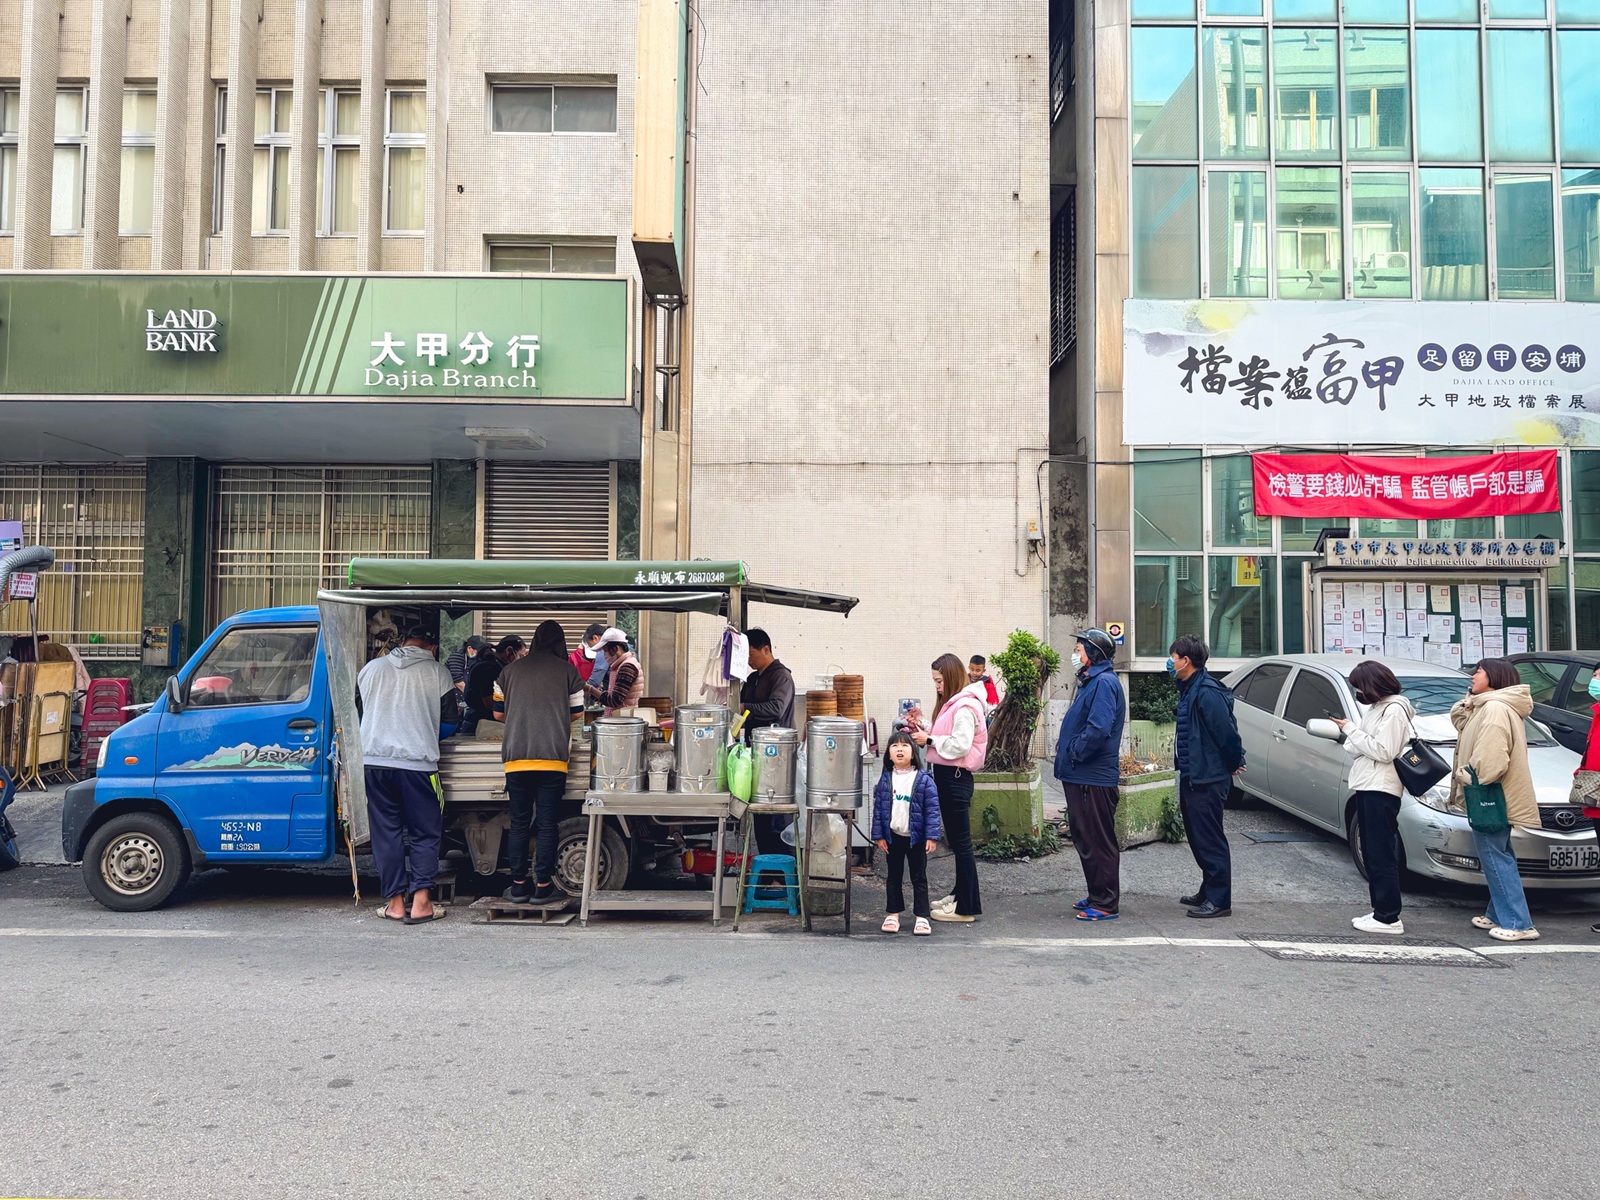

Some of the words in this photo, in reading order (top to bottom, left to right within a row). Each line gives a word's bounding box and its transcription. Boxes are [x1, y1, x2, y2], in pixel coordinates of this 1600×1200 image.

[146, 309, 217, 329] LAND
[146, 332, 217, 352] BANK
[370, 331, 540, 368] 大甲分行
[1421, 347, 1583, 369] 足留甲安埔
[364, 368, 434, 390] Dajia
[443, 368, 536, 388] Branch
[1453, 378, 1483, 386] DAJIA
[1487, 378, 1515, 386] LAND
[1519, 379, 1556, 387] OFFICE
[1418, 393, 1587, 409] 大甲地政檔案展
[1268, 472, 1403, 499] 檢警要錢必詐騙
[1411, 469, 1545, 499] 監管帳戶都是騙
[1332, 541, 1555, 556] 臺中市大甲地政事務所公告欄
[1339, 557, 1380, 567] Taichung
[1381, 557, 1399, 567] City
[1406, 557, 1429, 567] Dajia
[1430, 557, 1452, 566] Land
[1486, 557, 1521, 566] Bulletin
[1522, 557, 1549, 566] Board
[634, 571, 687, 584] 永順帆布
[688, 572, 725, 583] 26870348
